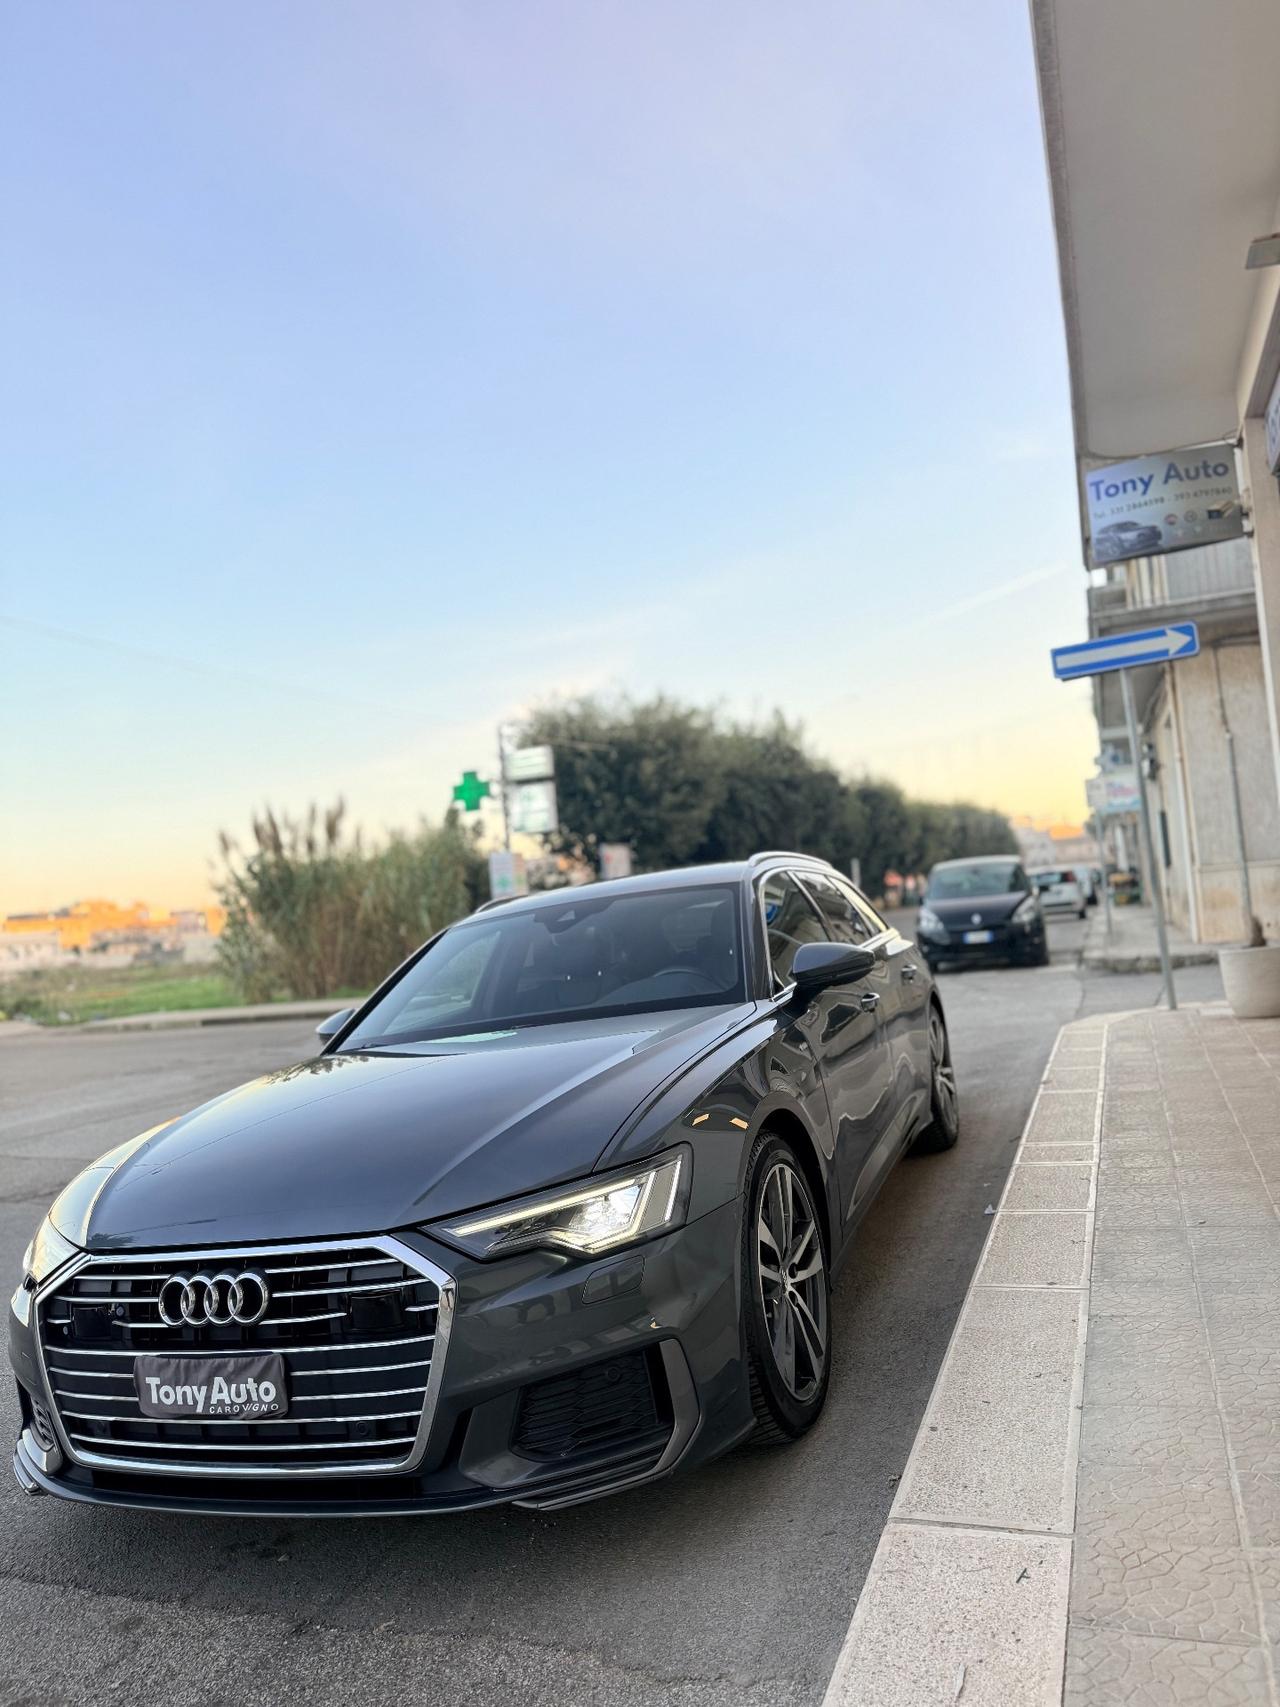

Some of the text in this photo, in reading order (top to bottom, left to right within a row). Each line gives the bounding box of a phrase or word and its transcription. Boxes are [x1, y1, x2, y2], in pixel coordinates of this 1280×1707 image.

[1090, 460, 1229, 501] Tony Auto
[209, 1403, 279, 1414] CAROVIGNO
